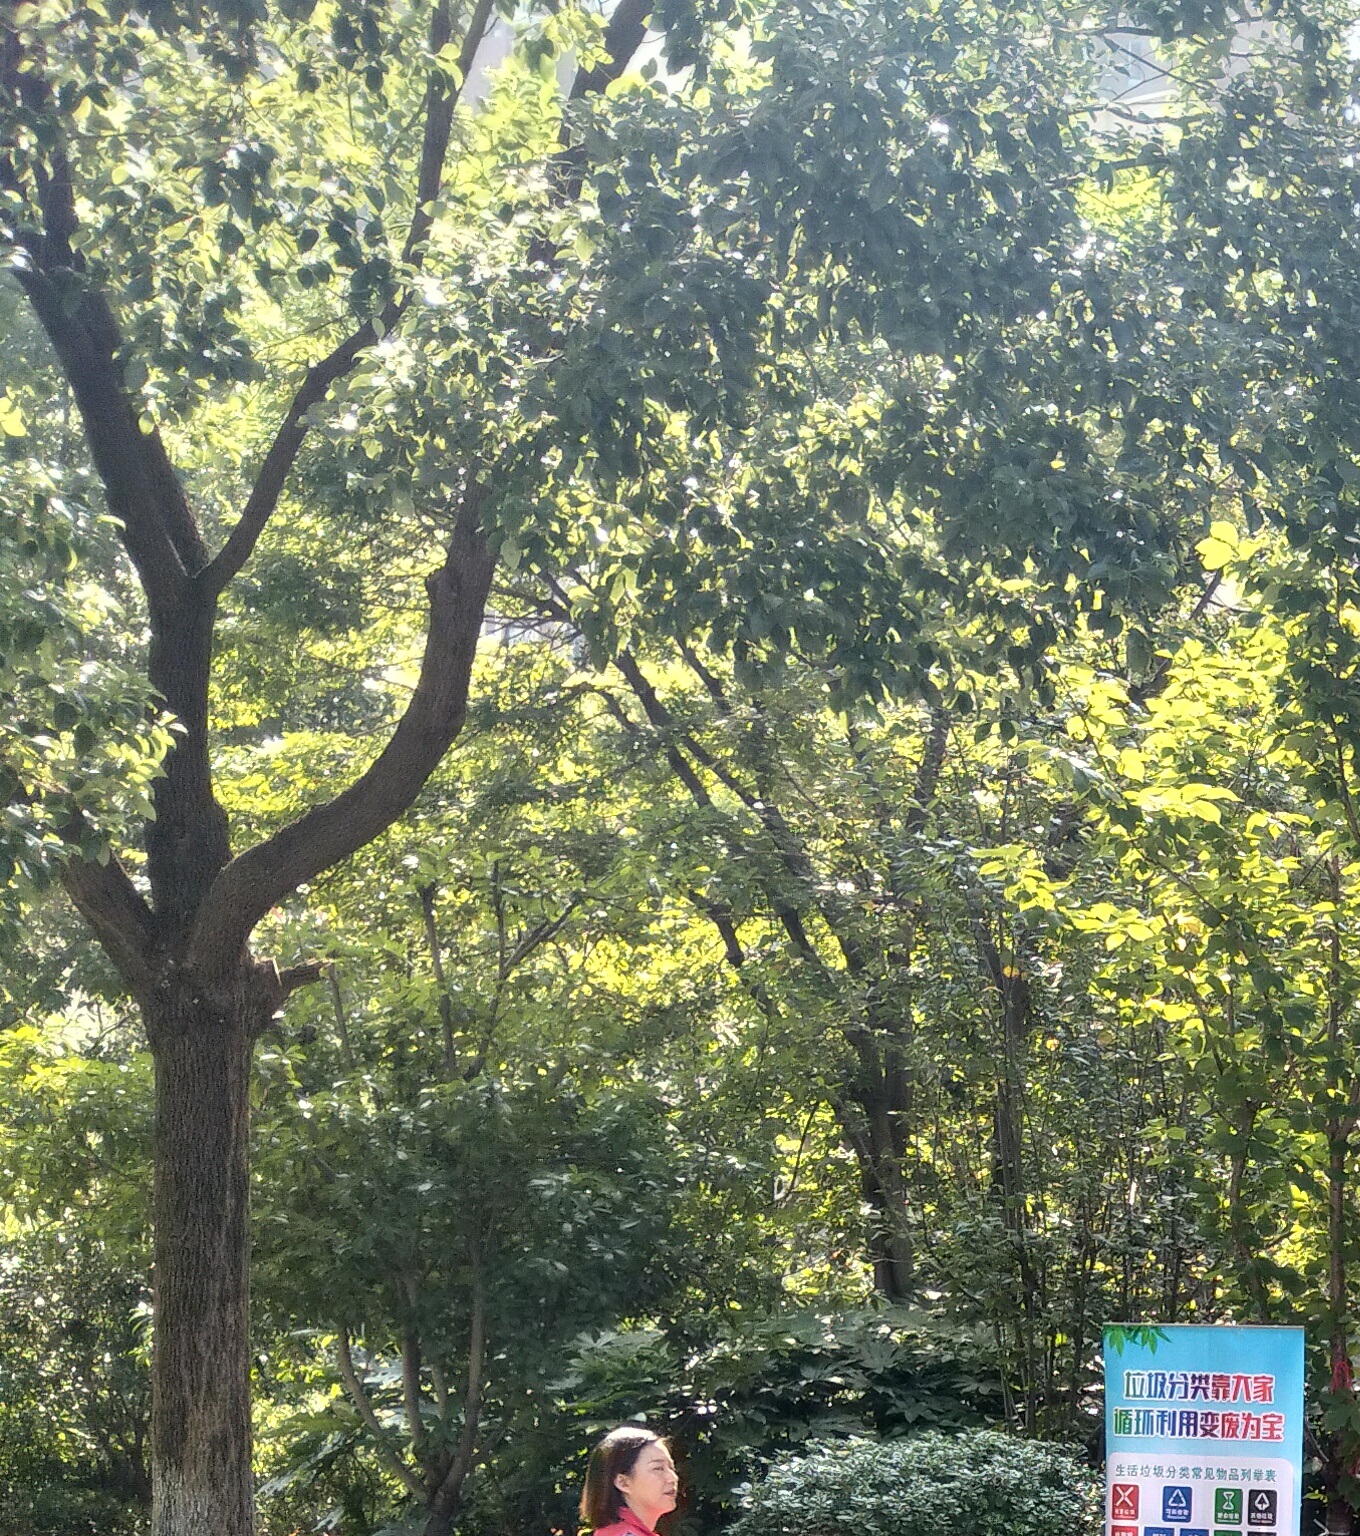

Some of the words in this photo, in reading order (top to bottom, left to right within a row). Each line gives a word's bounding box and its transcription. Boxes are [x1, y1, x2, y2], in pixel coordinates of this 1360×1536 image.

[1124, 1371, 1275, 1402] 垃圾分类靠大家
[1113, 1408, 1284, 1441] 循环利用变废为宝
[1115, 1464, 1277, 1482] 生活垃圾分类常见物品列举表
